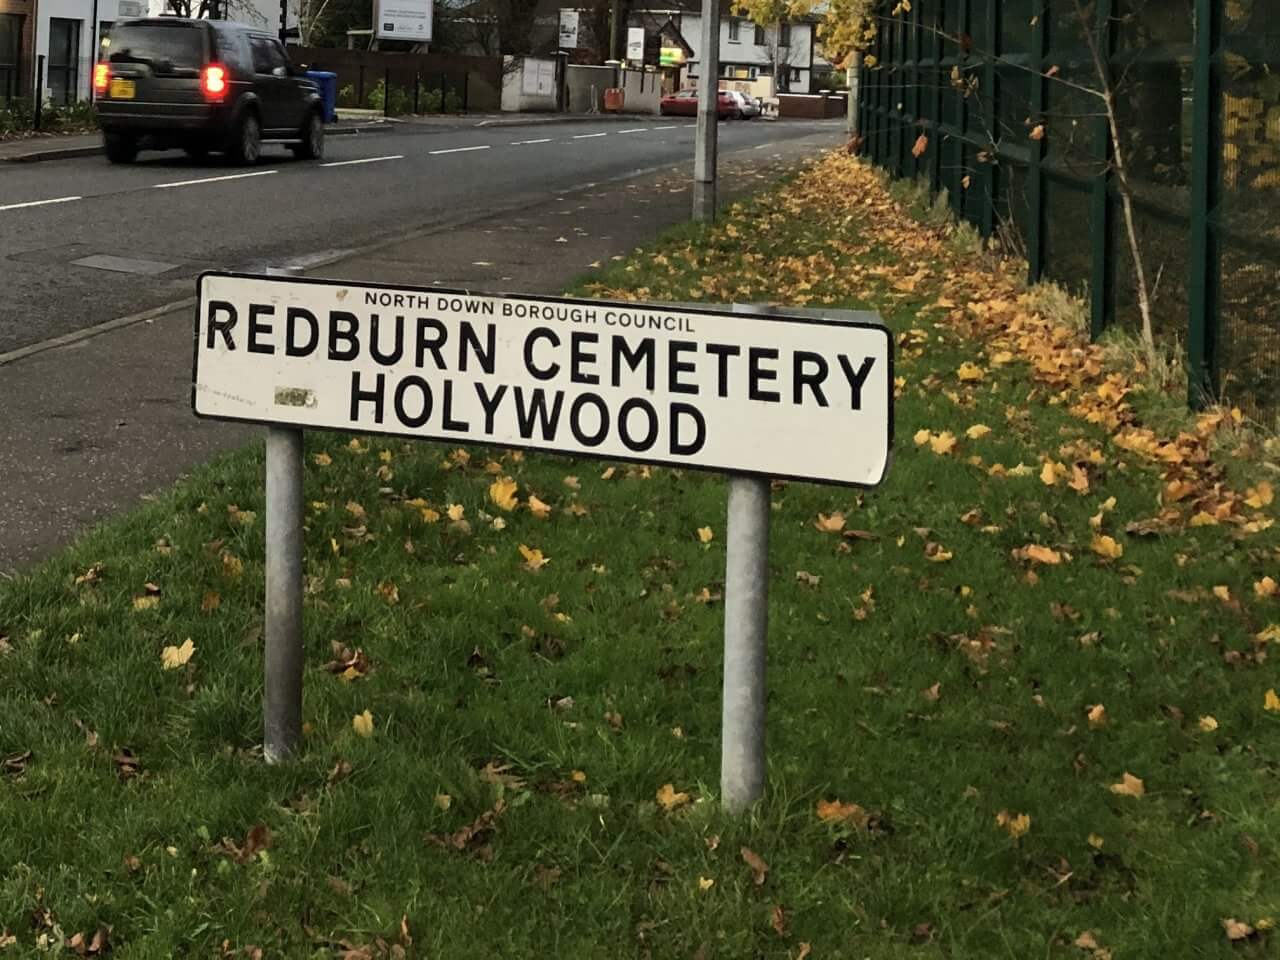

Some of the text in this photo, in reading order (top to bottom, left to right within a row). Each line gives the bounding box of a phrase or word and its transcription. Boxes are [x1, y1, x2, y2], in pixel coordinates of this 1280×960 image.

[365, 291, 696, 333] NORTH DOWN BOROUGH COUNCIL
[206, 299, 877, 411] REDBURN CEMETERY
[349, 371, 707, 456] HOLYWOOD
